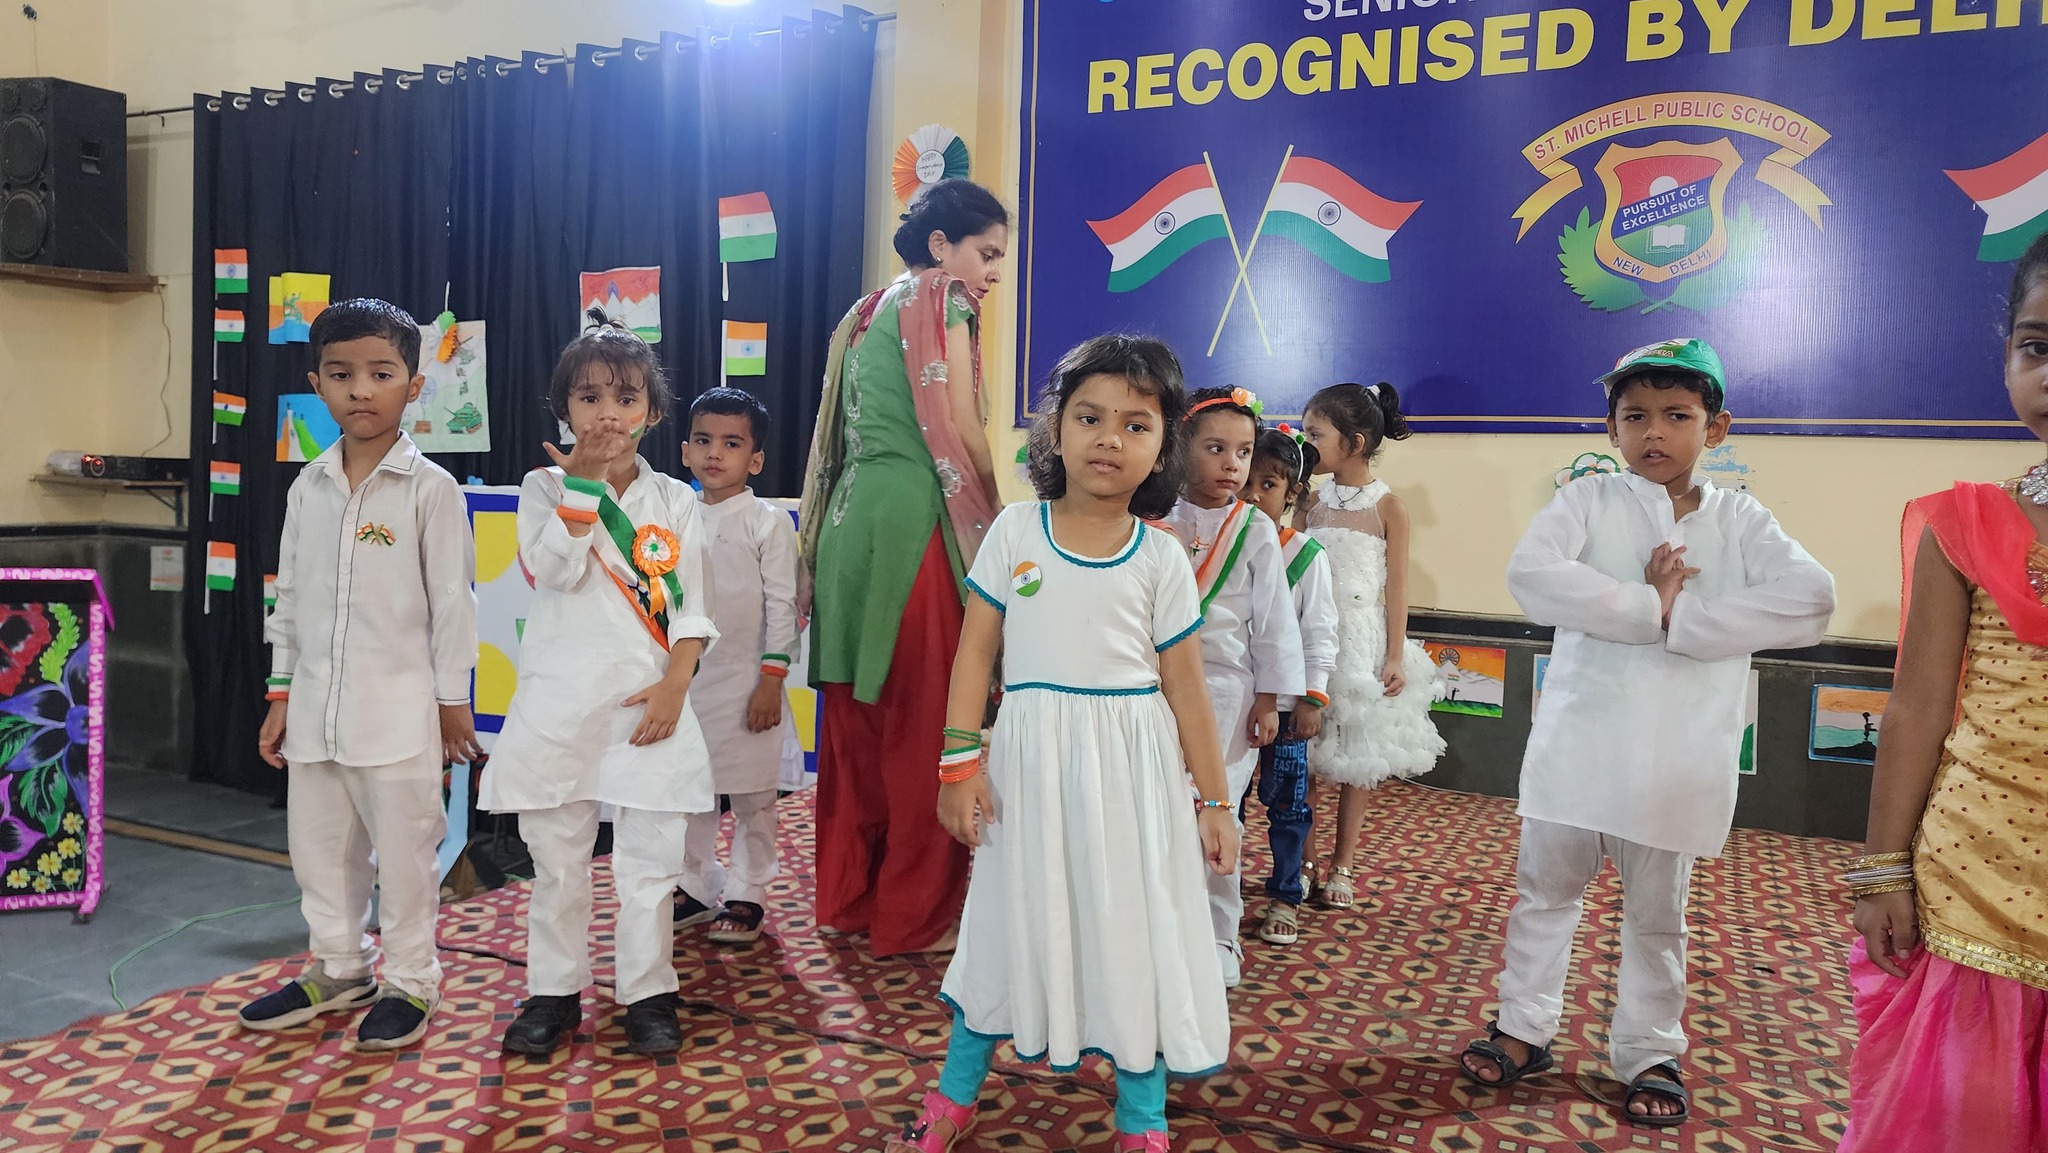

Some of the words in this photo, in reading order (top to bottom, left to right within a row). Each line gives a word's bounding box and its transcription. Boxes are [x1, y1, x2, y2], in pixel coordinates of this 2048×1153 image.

[1087, 8, 1595, 114] RECOGNISED
[1626, 0, 1750, 62] BY
[1534, 136, 1560, 159] ST.
[1564, 106, 1647, 144] MICHELL
[1653, 101, 1725, 119] PUBLIC
[1731, 104, 1809, 145] SCHOOL
[1622, 191, 1676, 217] PURSUIT
[1680, 184, 1697, 197] OF
[1622, 194, 1706, 230] EXCELLENCE
[1612, 256, 1644, 276] NEW
[1669, 249, 1712, 275] DELHI
[1273, 758, 1297, 771] EAST
